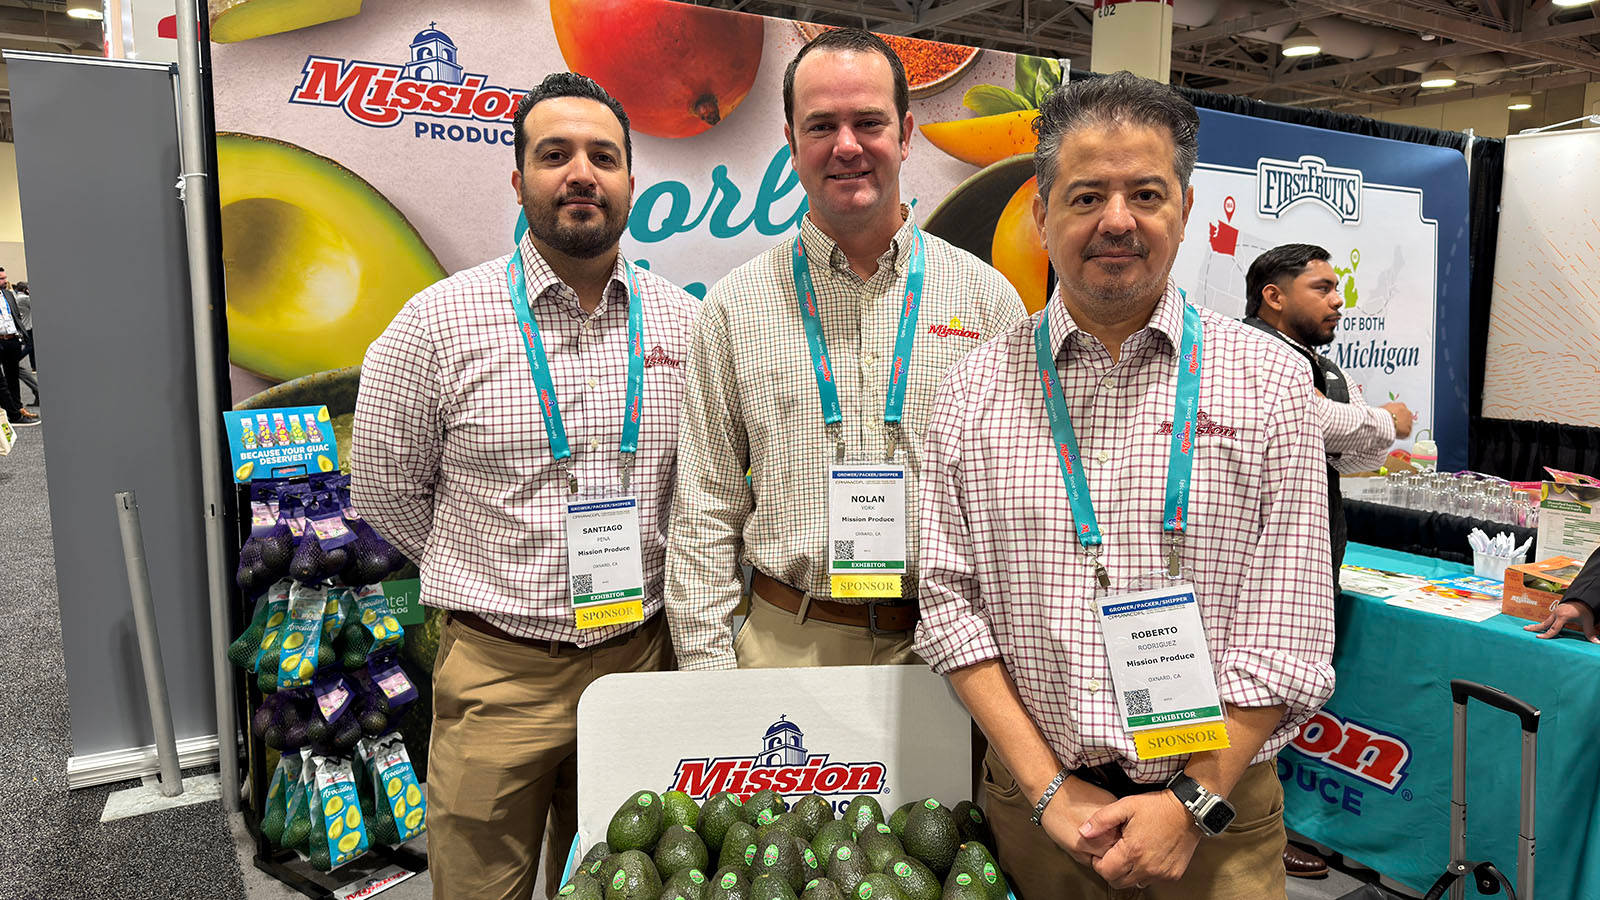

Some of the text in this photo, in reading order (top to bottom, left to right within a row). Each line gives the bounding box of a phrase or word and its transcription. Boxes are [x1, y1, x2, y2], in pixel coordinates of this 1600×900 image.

[414, 121, 515, 146] PRODUC
[1343, 317, 1356, 331] OF
[1359, 317, 1385, 331] BOTH
[928, 325, 980, 339] Mission
[644, 356, 680, 370] ission
[1335, 340, 1419, 375] Michigan
[240, 443, 330, 461] BECAUSE YOUR GUAC
[260, 453, 313, 465] DESERVES IT
[851, 495, 885, 503] NOLAN
[570, 501, 632, 512] GROWER/PACKER/SHIPPER
[582, 524, 623, 535] SANTIAGO
[577, 545, 631, 557] Mission Produce
[840, 581, 894, 591] SPONSOR
[590, 592, 625, 601] EXHIBITOR
[1108, 596, 1189, 613] GROWER/PACKER/SHIPPER
[582, 607, 634, 622] SPONSOR
[1131, 626, 1178, 640] ROBERTO
[1137, 640, 1177, 651] RODRIGUEZ
[1126, 652, 1195, 668] Mission Produce
[1148, 674, 1173, 683] OXNARD,
[1151, 711, 1197, 723] EXHIBITOR
[1147, 729, 1218, 750] SPONSOR
[671, 755, 884, 803] Mission
[1277, 757, 1364, 817] DUCE
